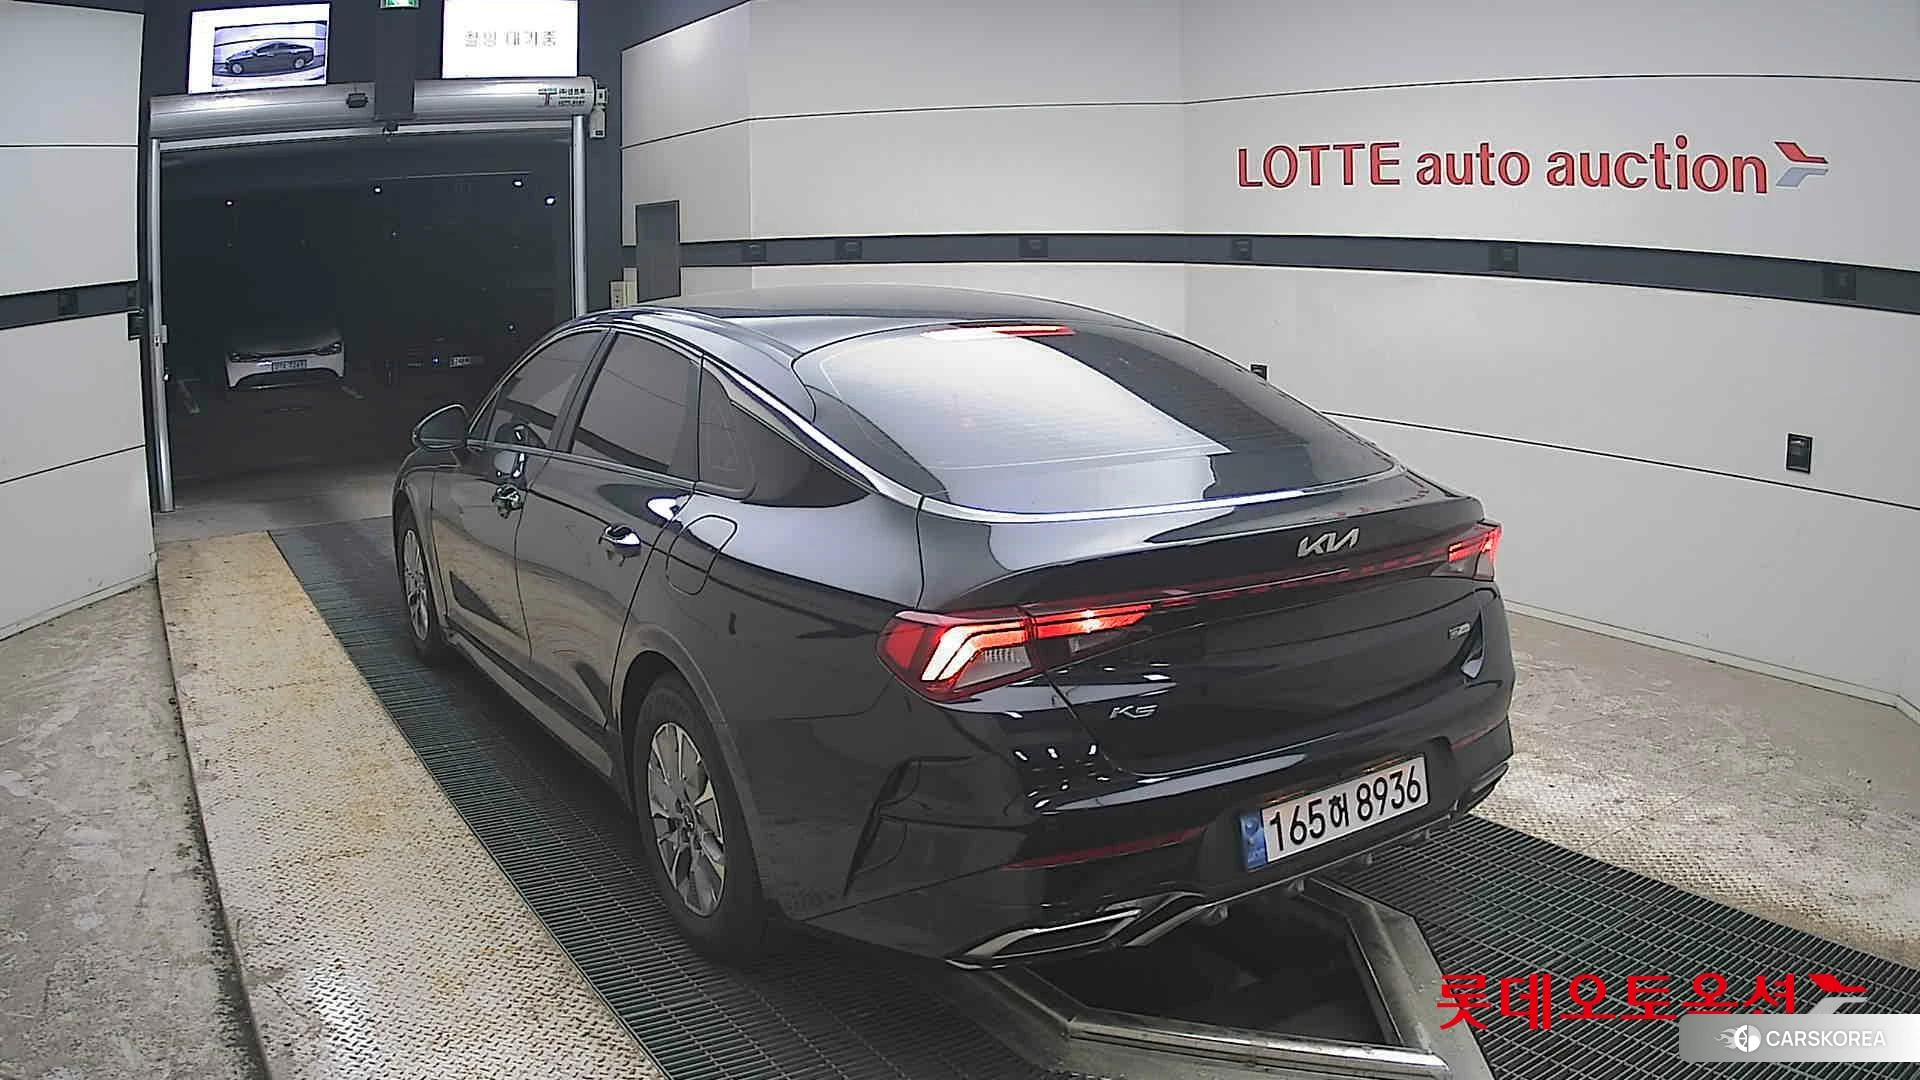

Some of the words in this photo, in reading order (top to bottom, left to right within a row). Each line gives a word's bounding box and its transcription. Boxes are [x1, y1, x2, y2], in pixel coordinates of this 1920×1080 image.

[1237, 141, 1401, 188] LOTTE
[1415, 142, 1531, 186] auto
[1545, 136, 1768, 193] auction
[1110, 704, 1158, 719] K5
